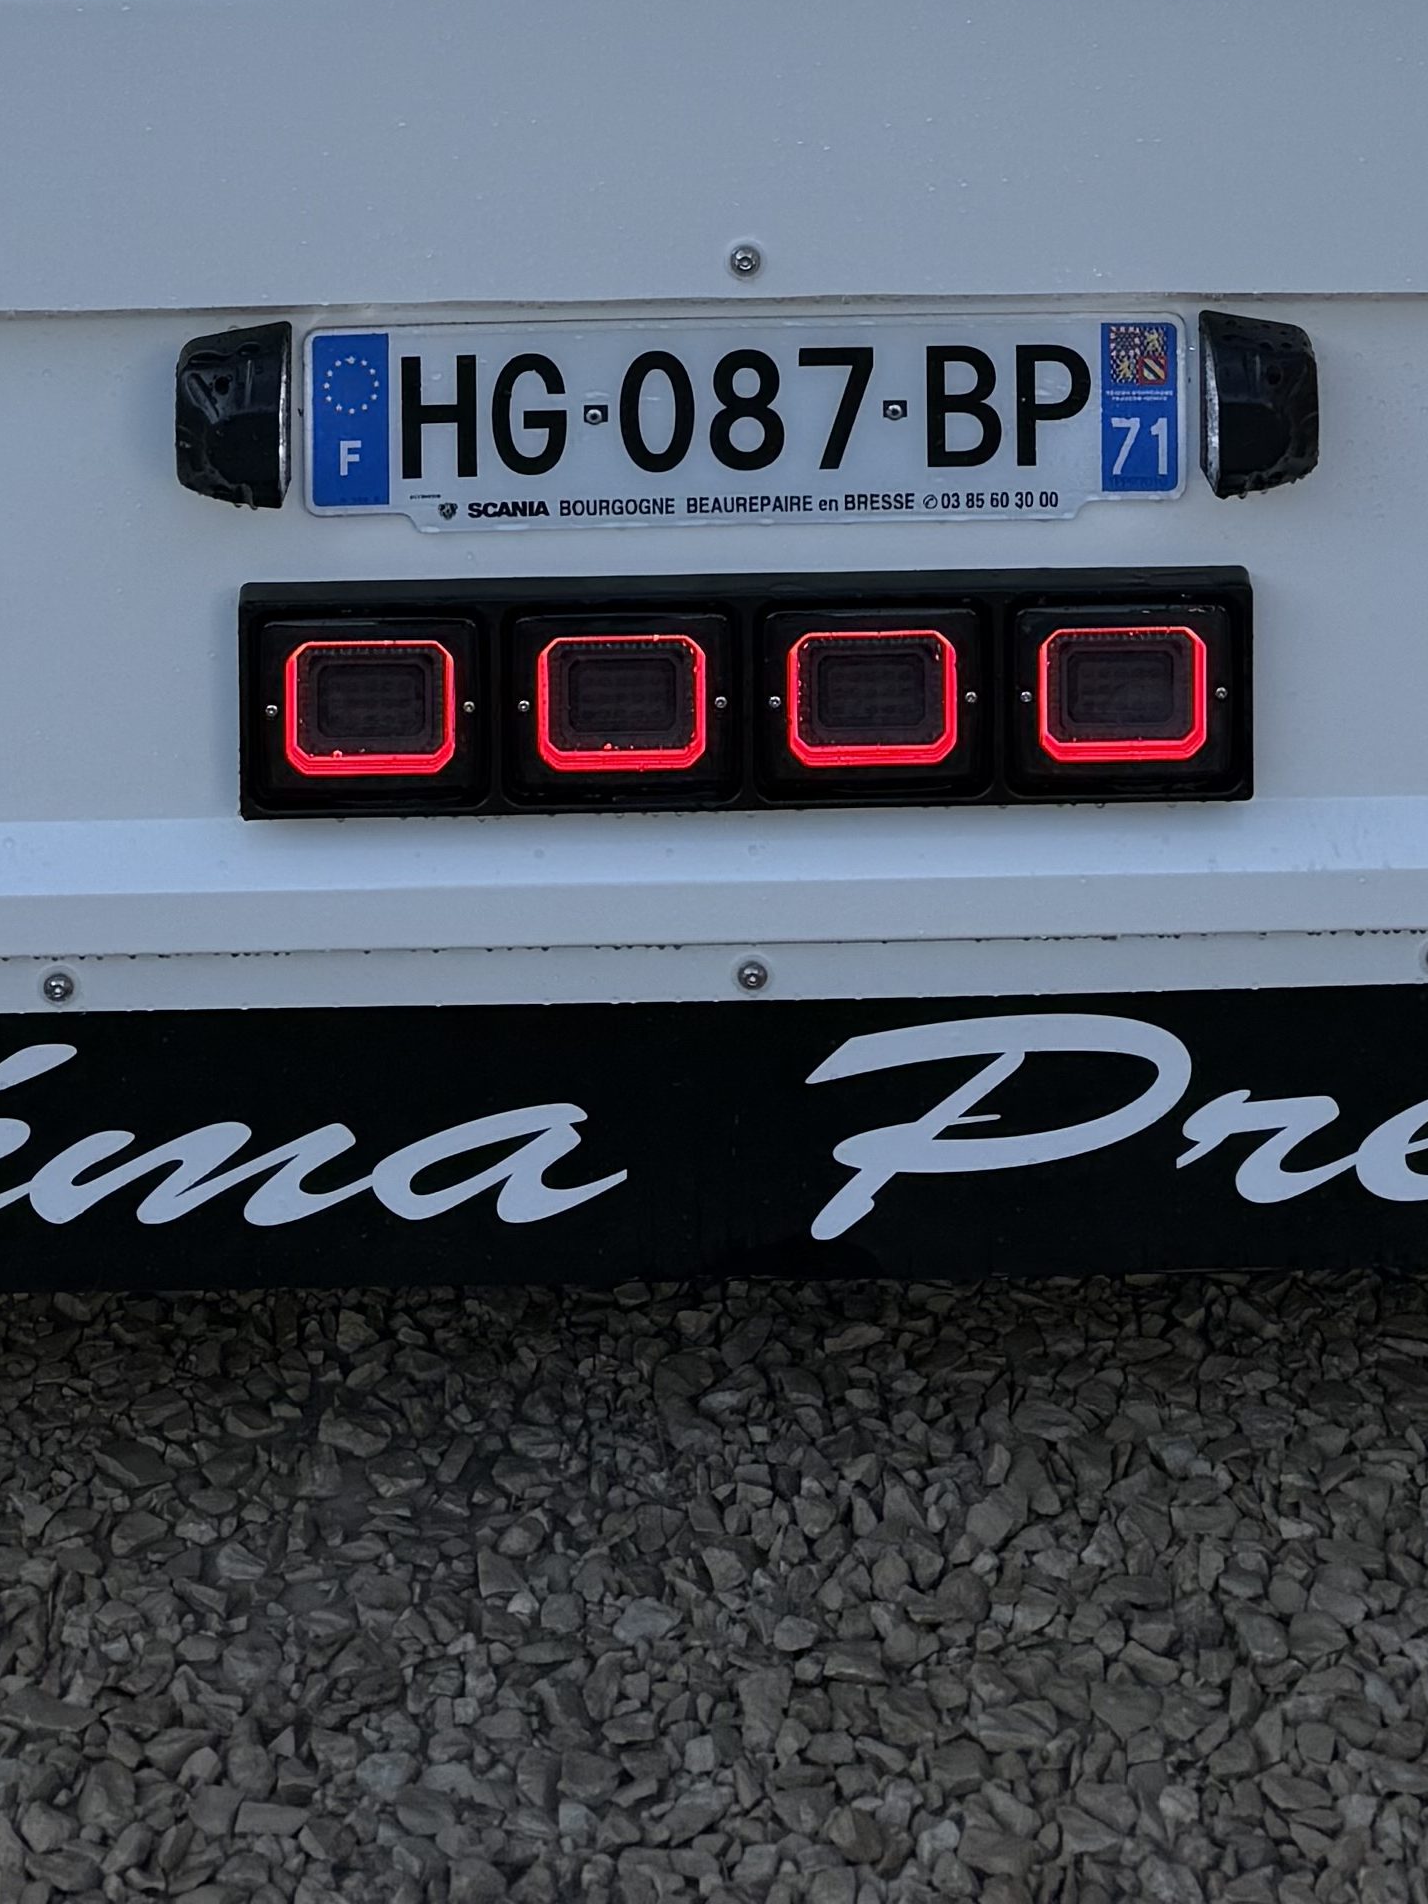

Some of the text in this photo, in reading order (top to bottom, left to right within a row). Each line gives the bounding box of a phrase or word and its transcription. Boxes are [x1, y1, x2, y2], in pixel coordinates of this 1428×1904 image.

[340, 440, 362, 476] F
[1110, 417, 1169, 476] 71
[467, 491, 1060, 520] SCANIA BOURGOGNE BEAUREPAIRE en BRESSE 03 85 60 30 00
